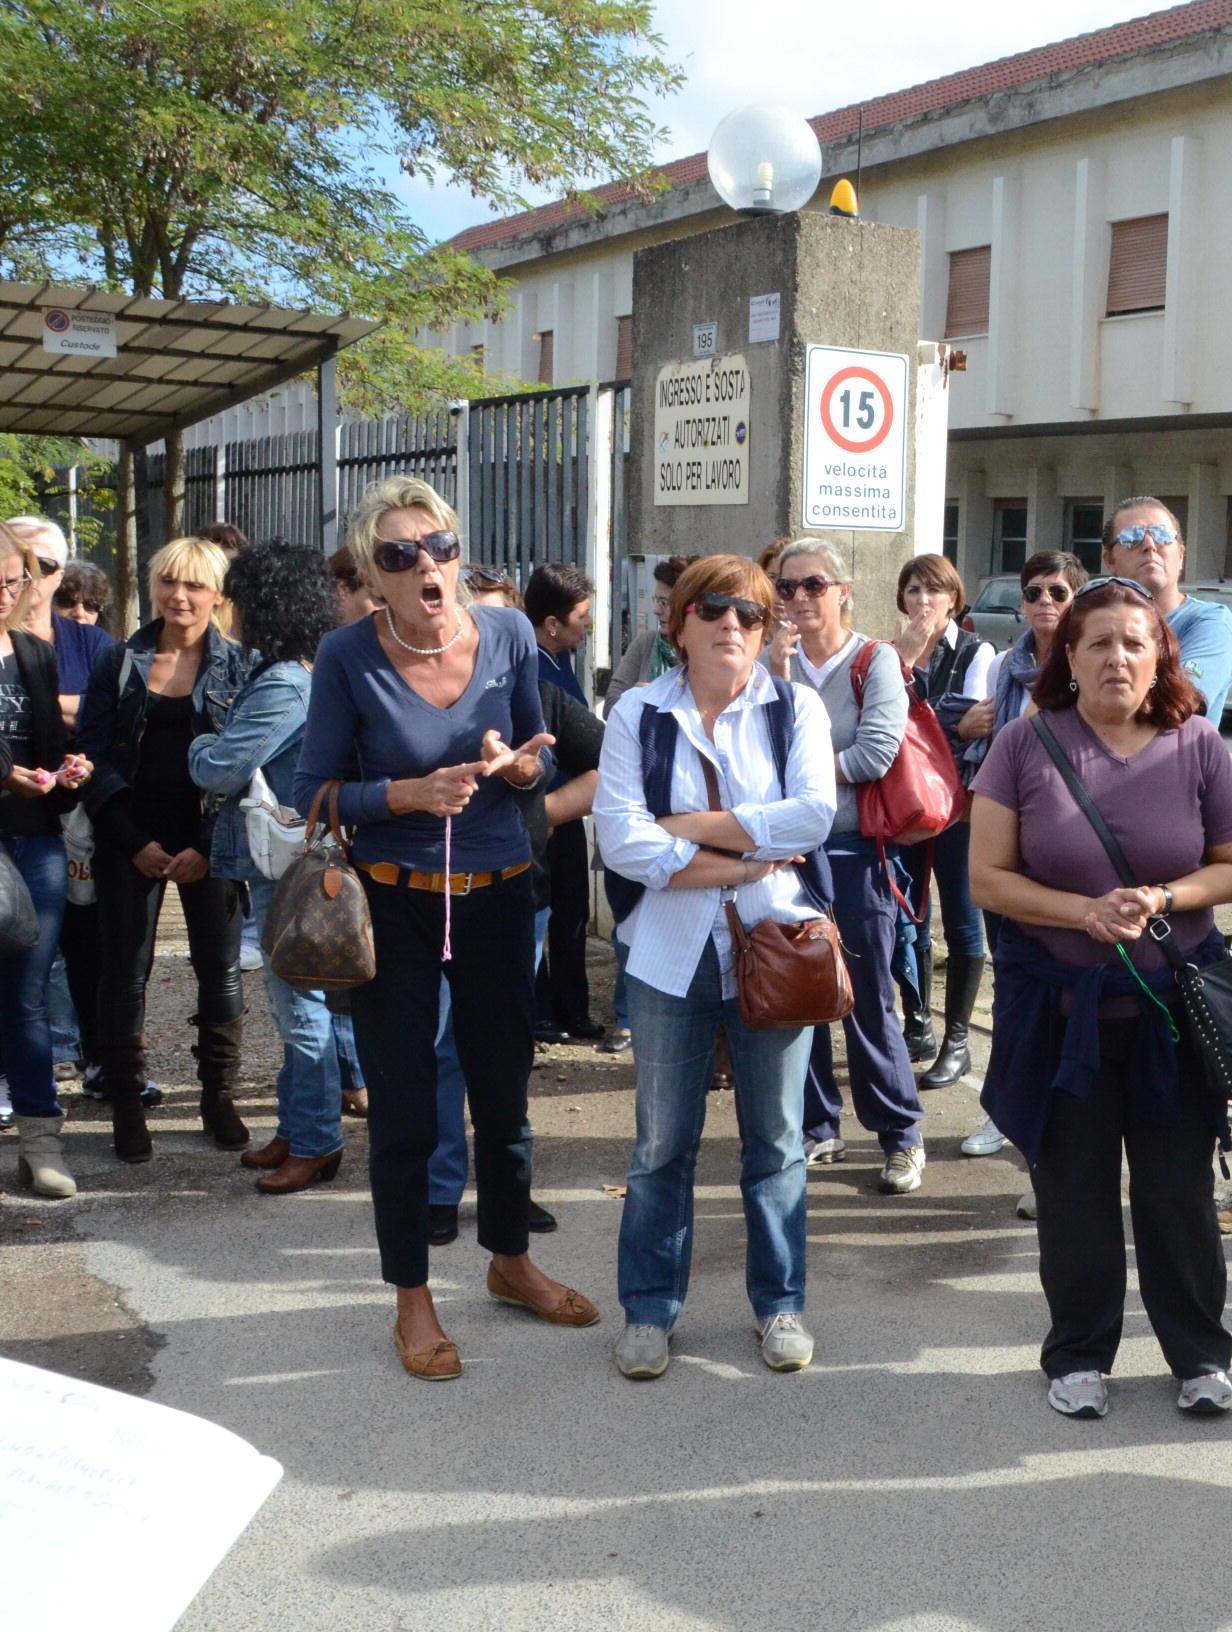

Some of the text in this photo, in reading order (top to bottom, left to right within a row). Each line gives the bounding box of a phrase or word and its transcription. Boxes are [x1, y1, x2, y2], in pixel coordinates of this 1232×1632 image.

[72, 324, 110, 335] RISERVATO
[60, 339, 101, 351] Custode
[697, 332, 713, 349] 195
[660, 369, 745, 408] INGRESSO E SOSTA
[840, 389, 875, 430] 15
[673, 415, 730, 449] AUTORIZZATI
[660, 458, 741, 491] SOLO PER LAVORO
[819, 483, 891, 499] massima
[812, 504, 897, 519] consentita
